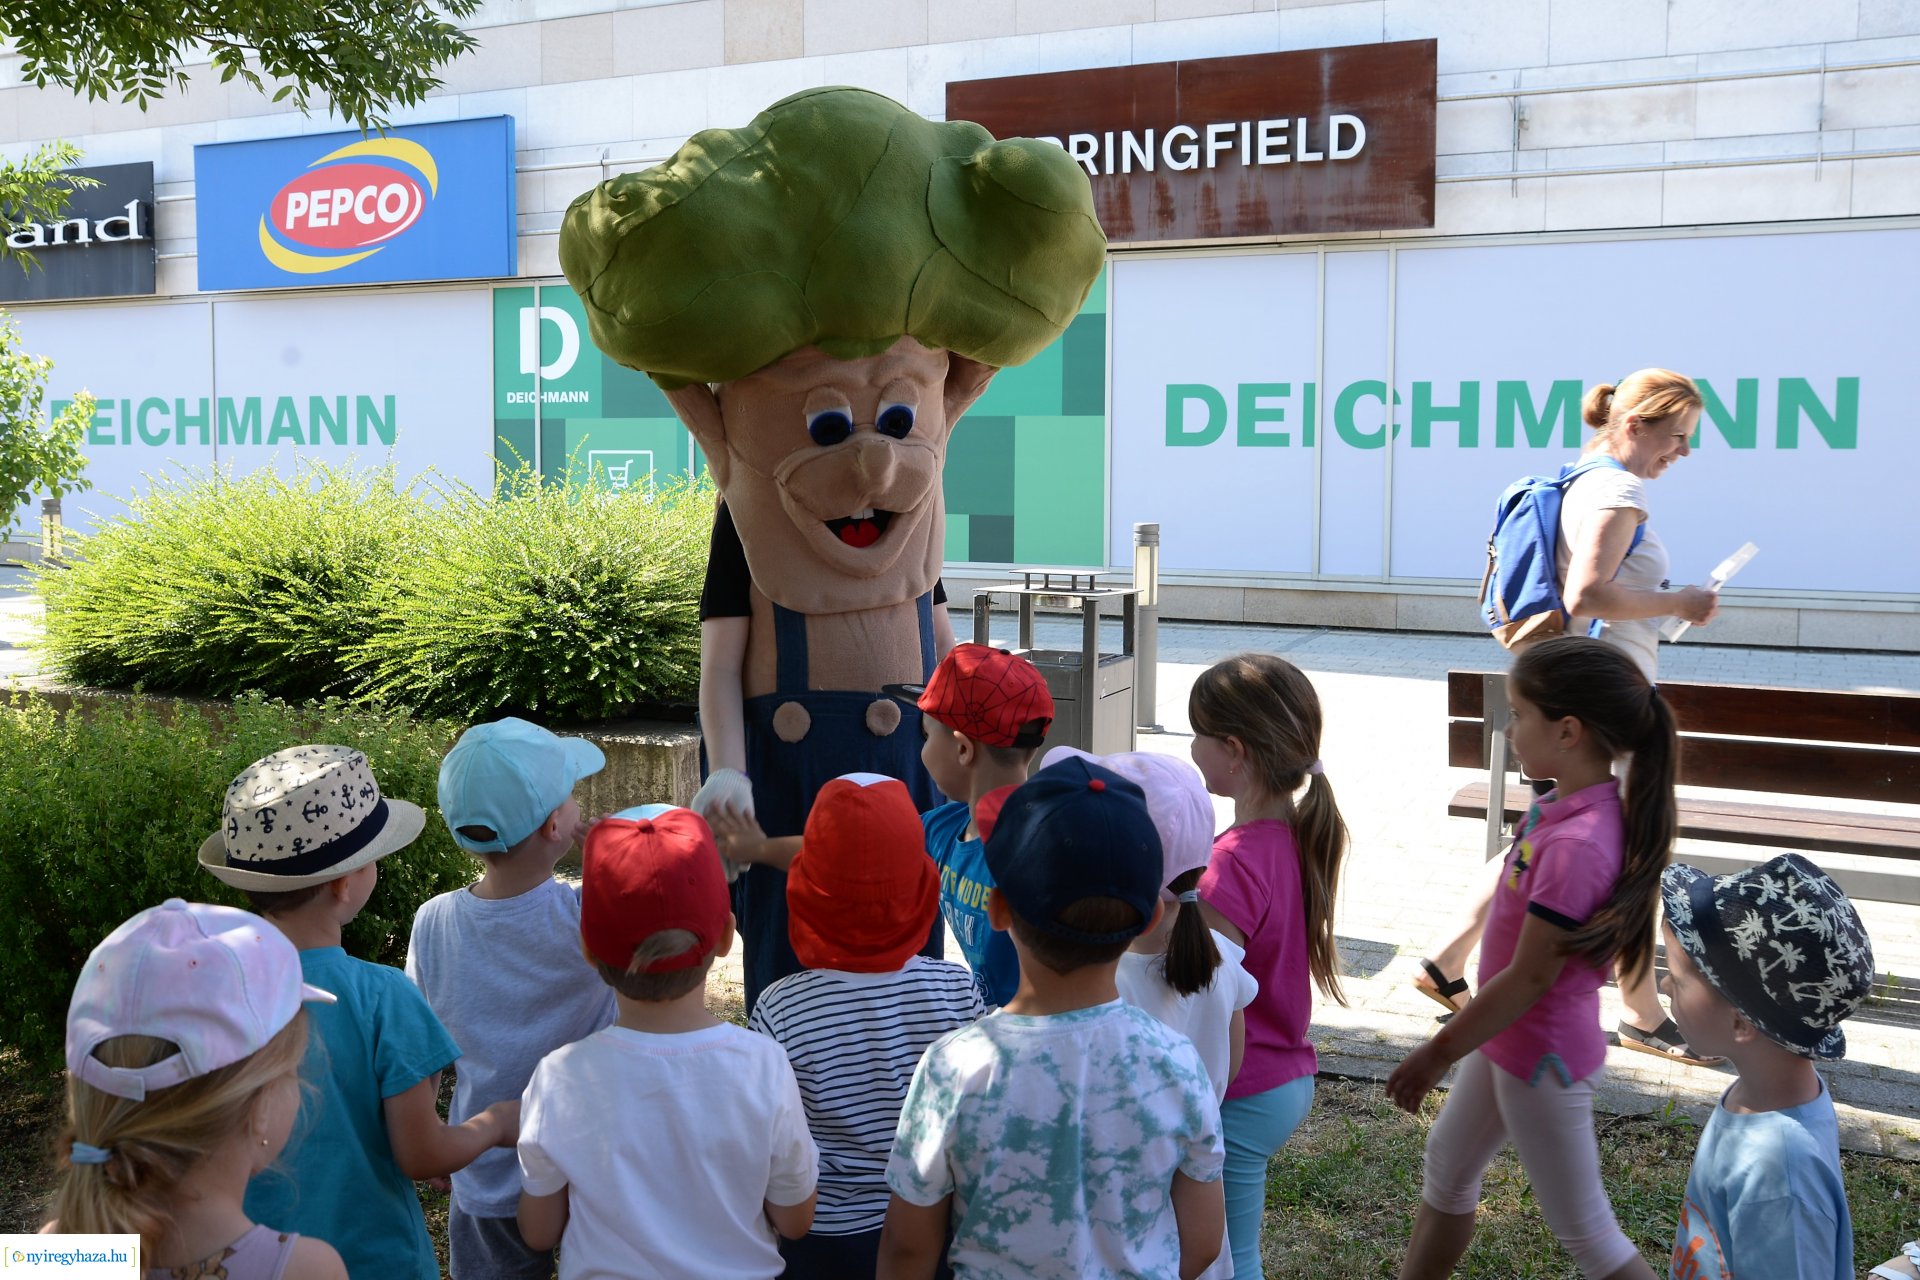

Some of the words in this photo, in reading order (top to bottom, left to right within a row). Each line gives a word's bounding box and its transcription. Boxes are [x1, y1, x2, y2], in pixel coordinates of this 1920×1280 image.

[1035, 114, 1366, 175] RINGFIELD
[286, 183, 409, 230] PEPCO
[520, 307, 580, 380] D
[1165, 376, 1860, 450] DEICHMNN
[956, 876, 992, 911] MODE
